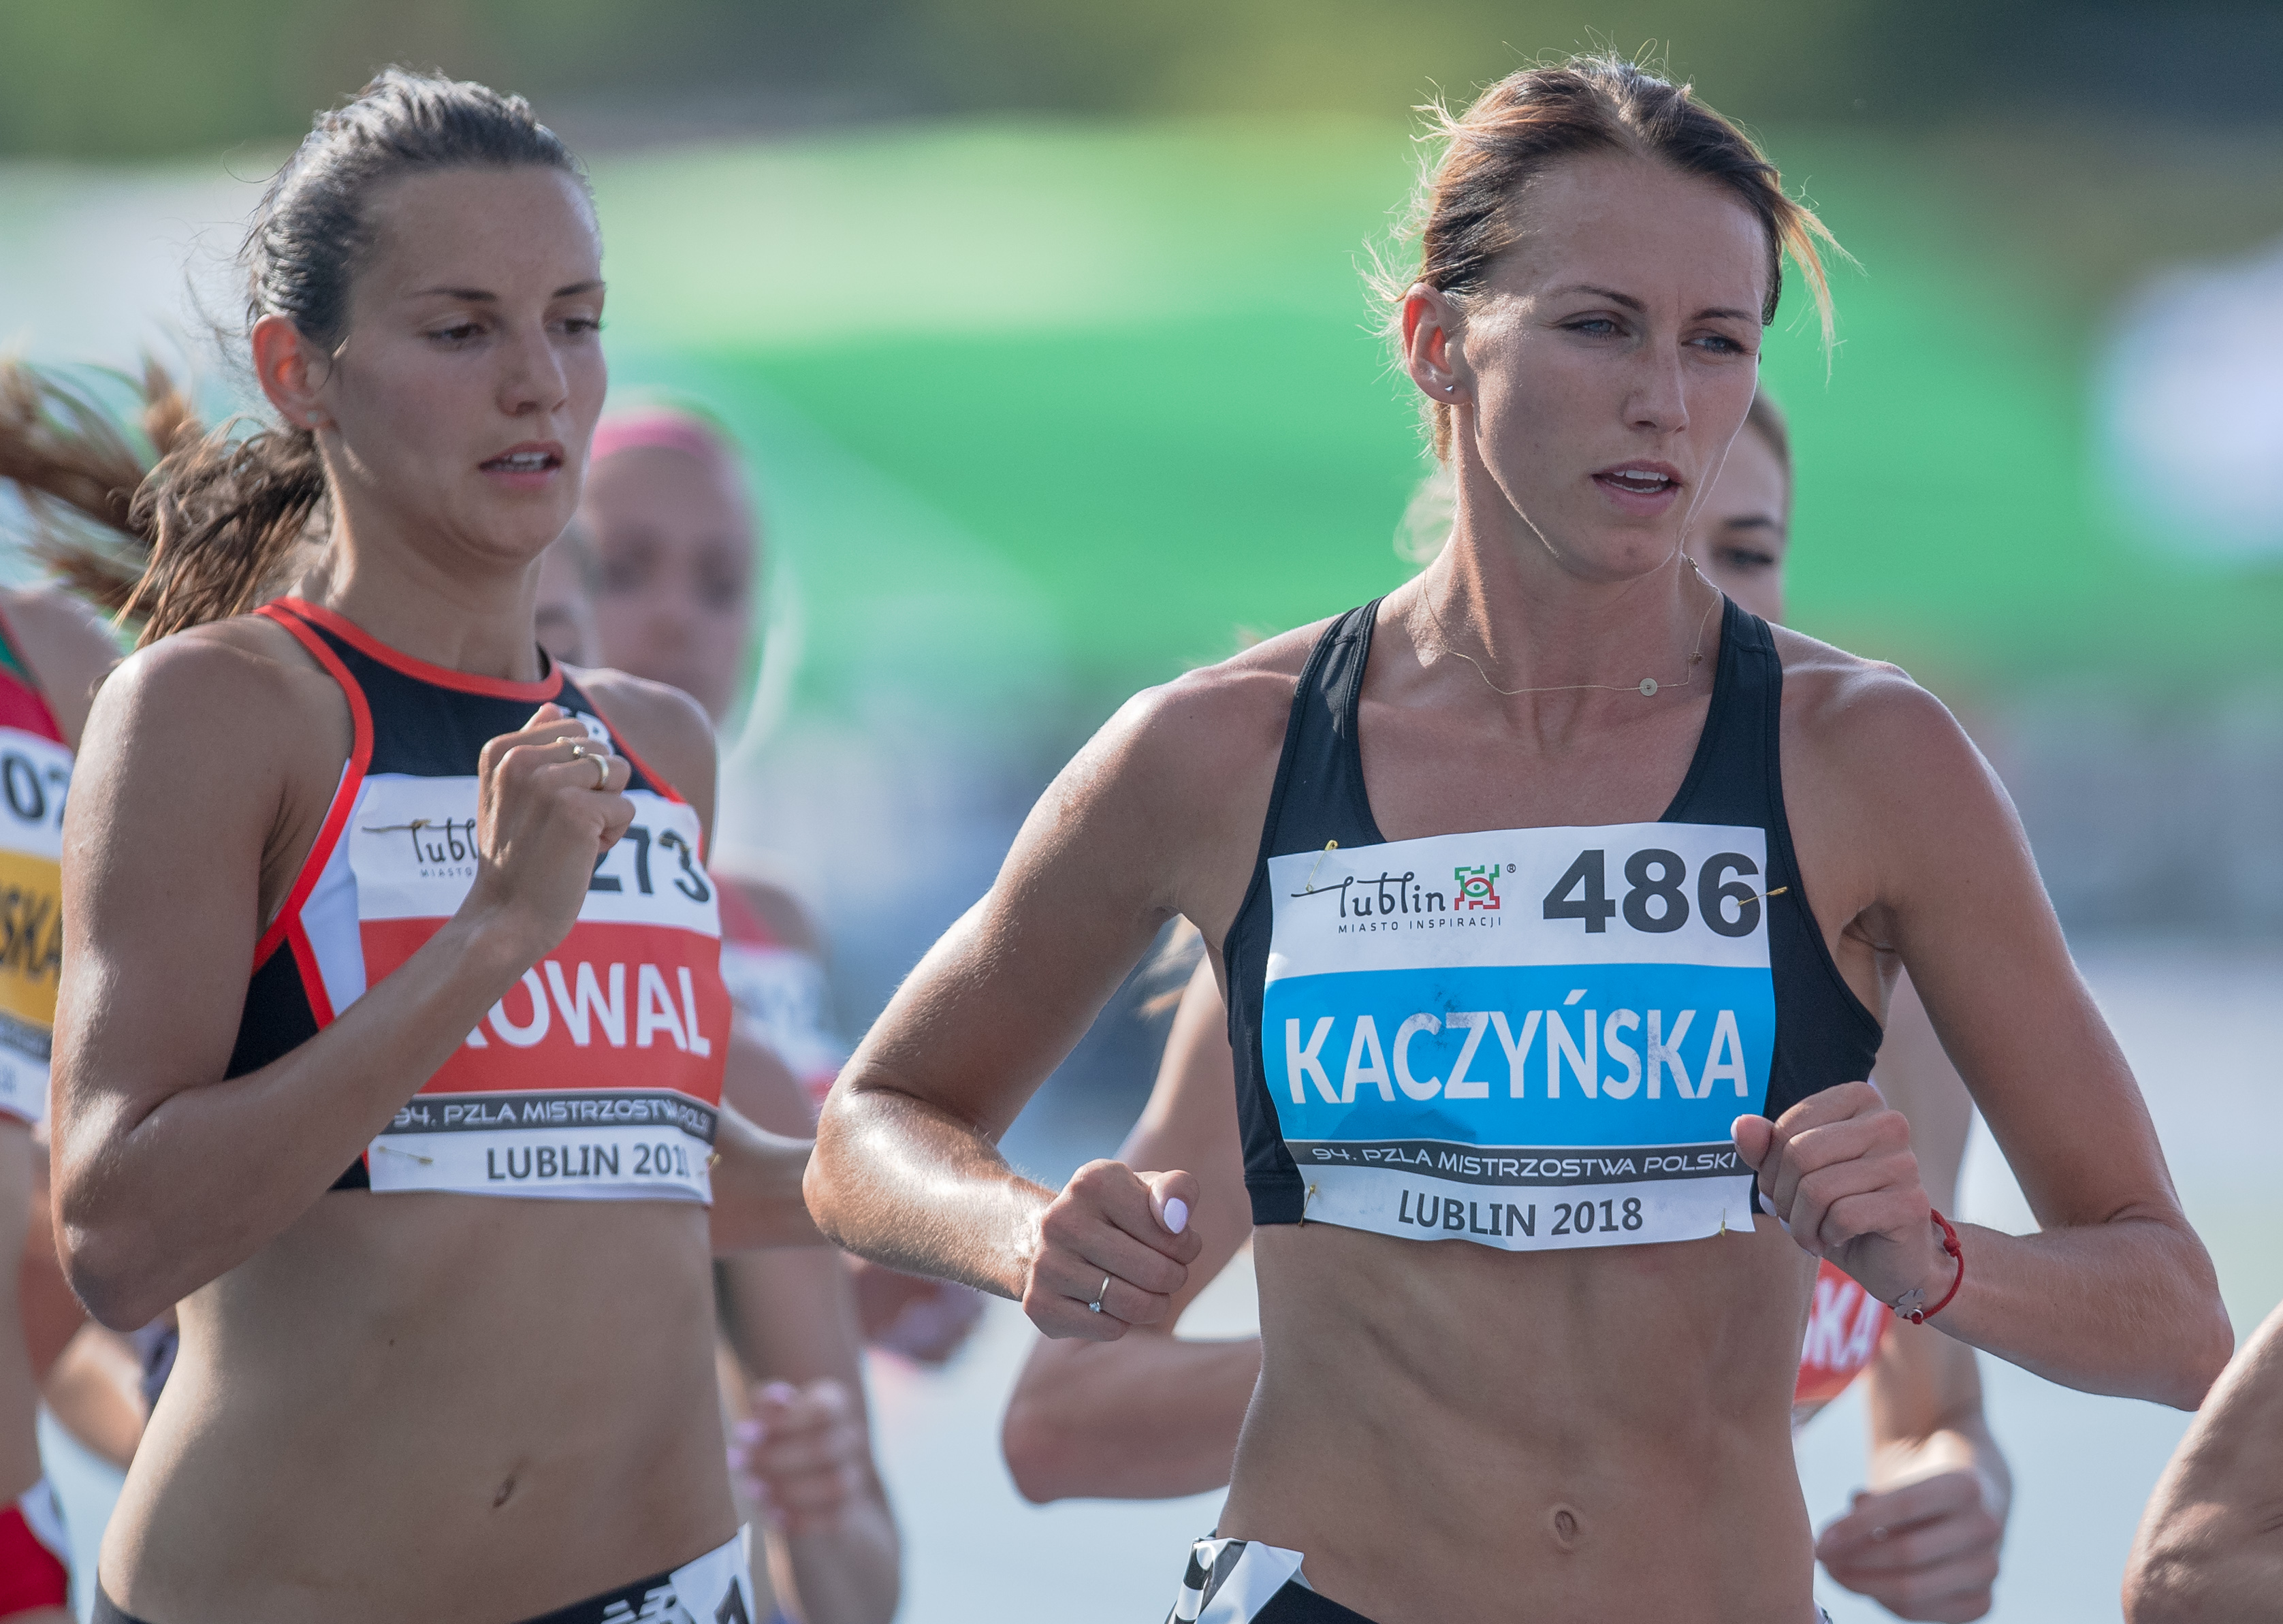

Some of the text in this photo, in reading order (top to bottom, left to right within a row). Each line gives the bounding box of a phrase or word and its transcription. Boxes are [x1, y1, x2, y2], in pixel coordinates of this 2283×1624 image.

[420, 866, 473, 878] MIASTO
[1542, 848, 1761, 938] 486
[1338, 917, 1501, 934] MIASTO INSPIRACJI
[465, 959, 711, 1059] OWAL
[1284, 989, 1749, 1105] KACZYŃSKA
[443, 1102, 517, 1126] PZLA
[486, 1141, 690, 1180] LUBLIN 201
[1311, 1147, 1736, 1177] 94. PZLA MISTRZOSTWA POLSKI
[1398, 1189, 1643, 1237] LUBLIN 2018
